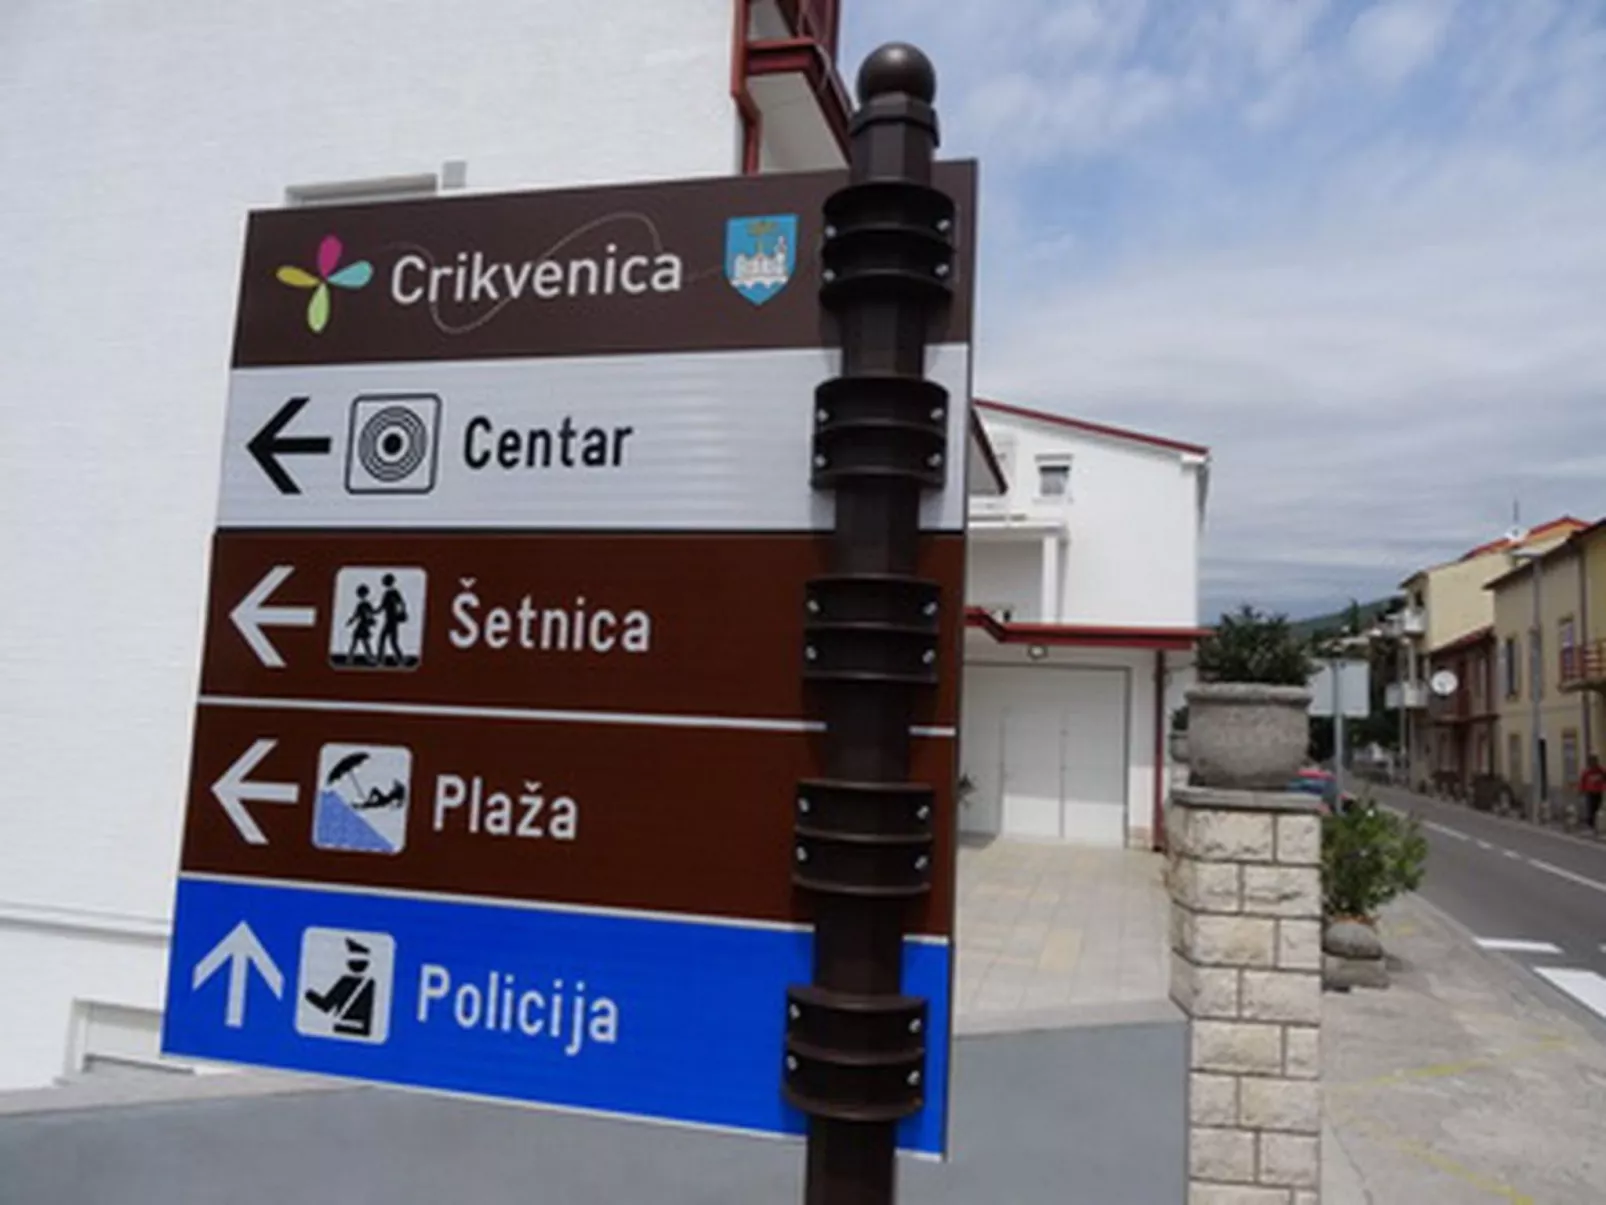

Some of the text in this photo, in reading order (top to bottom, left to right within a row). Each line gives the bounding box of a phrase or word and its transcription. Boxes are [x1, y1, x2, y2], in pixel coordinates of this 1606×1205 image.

[391, 243, 682, 304] Crikvenica
[463, 415, 633, 470] Centar
[449, 577, 651, 652] Šetnica
[433, 774, 578, 840] Plaža
[417, 963, 619, 1056] Policija
